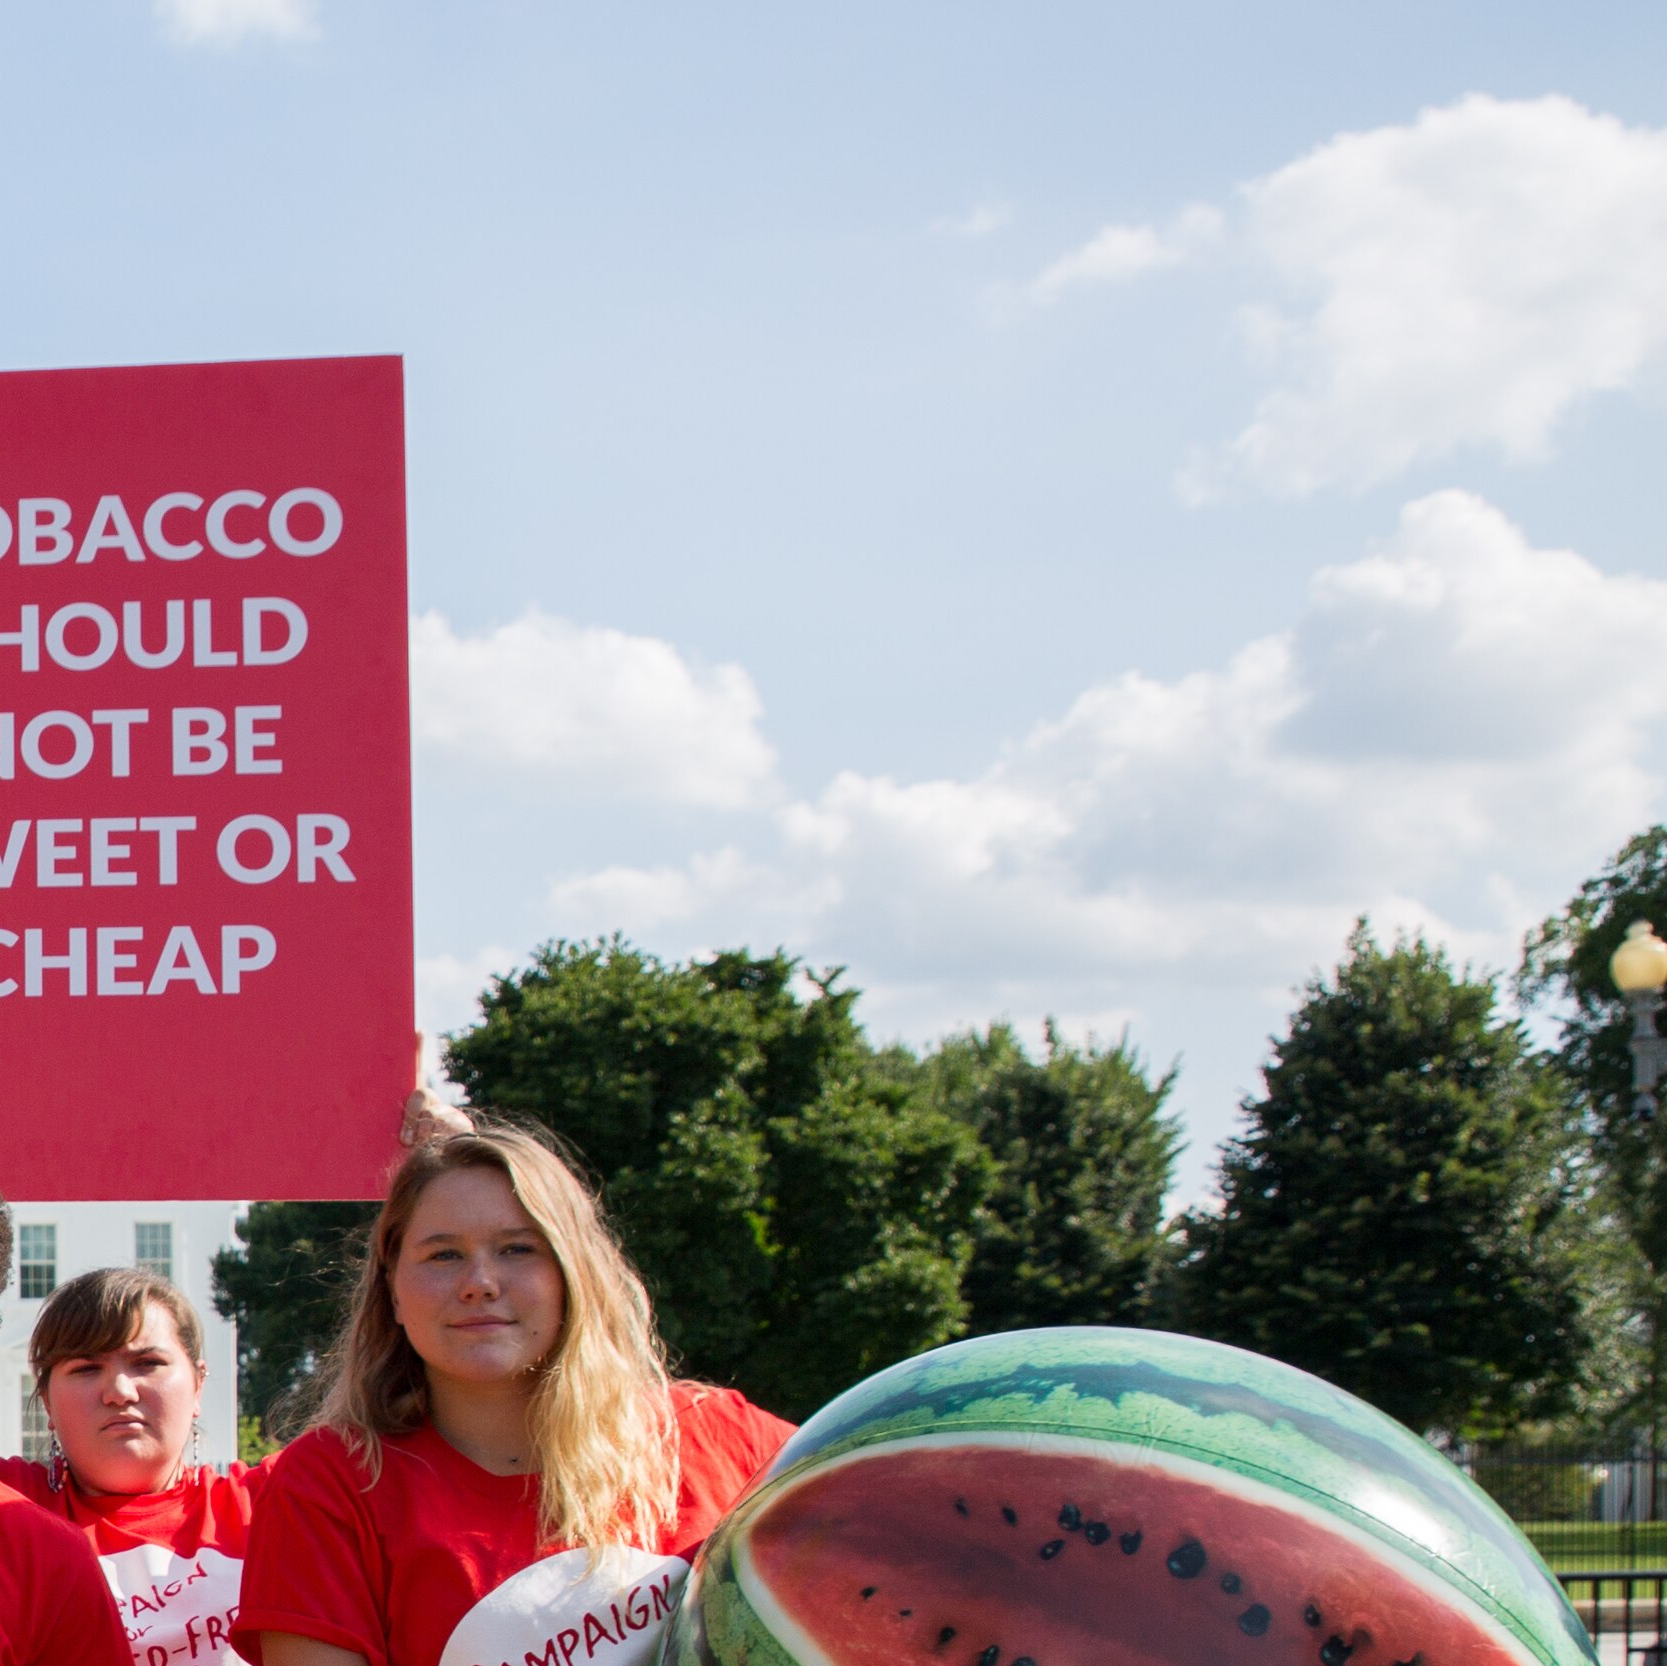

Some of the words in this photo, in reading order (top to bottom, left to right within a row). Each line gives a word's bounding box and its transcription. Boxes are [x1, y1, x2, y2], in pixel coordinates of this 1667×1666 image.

[172, 706, 282, 775] BE
[217, 814, 356, 884] OR
[125, 1625, 153, 1642] or
